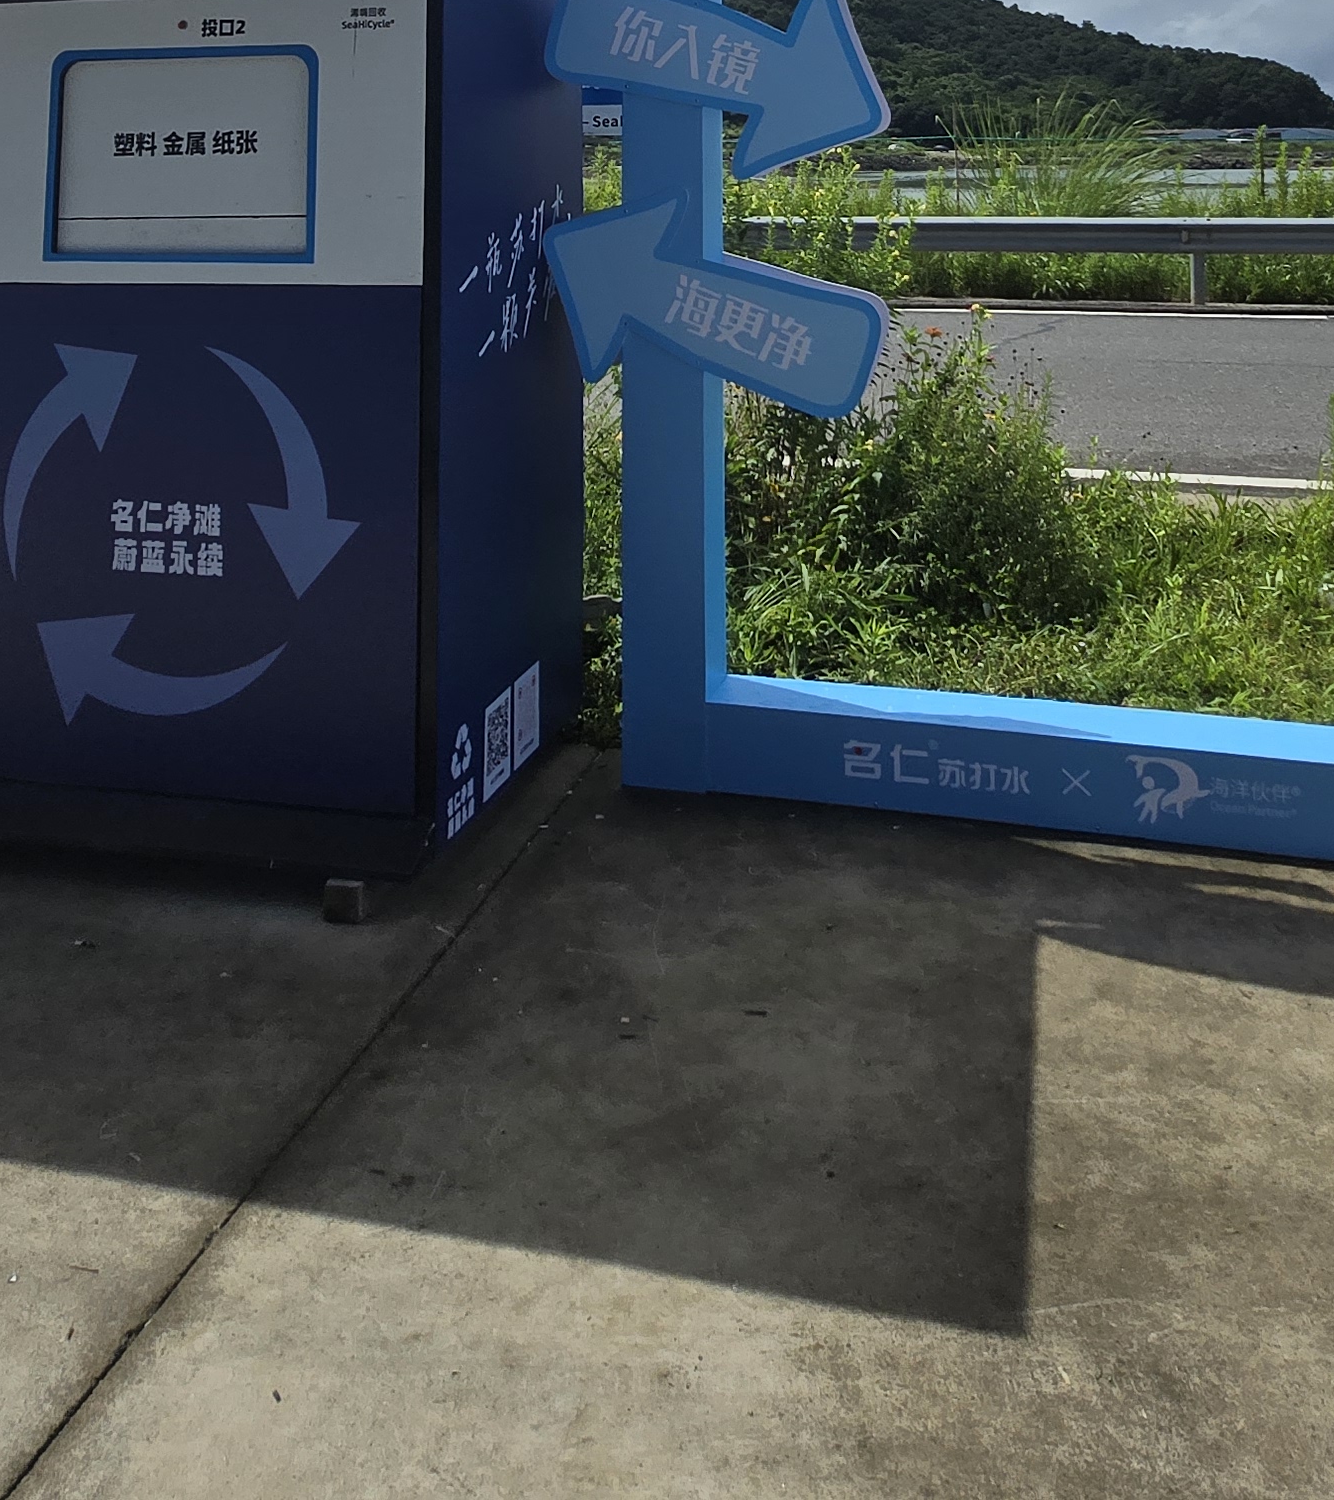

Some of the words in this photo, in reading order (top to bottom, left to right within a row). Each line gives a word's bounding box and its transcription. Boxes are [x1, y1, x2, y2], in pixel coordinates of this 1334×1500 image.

[200, 17, 246, 39] 投口2
[609, 5, 761, 95] 你入镜
[112, 132, 157, 158] 塑料
[162, 131, 206, 156] 金属
[212, 129, 258, 156] 纸张
[664, 273, 813, 370] 海更净
[110, 498, 221, 537] 名仁净滩
[111, 538, 223, 578] 蔚蓝永续
